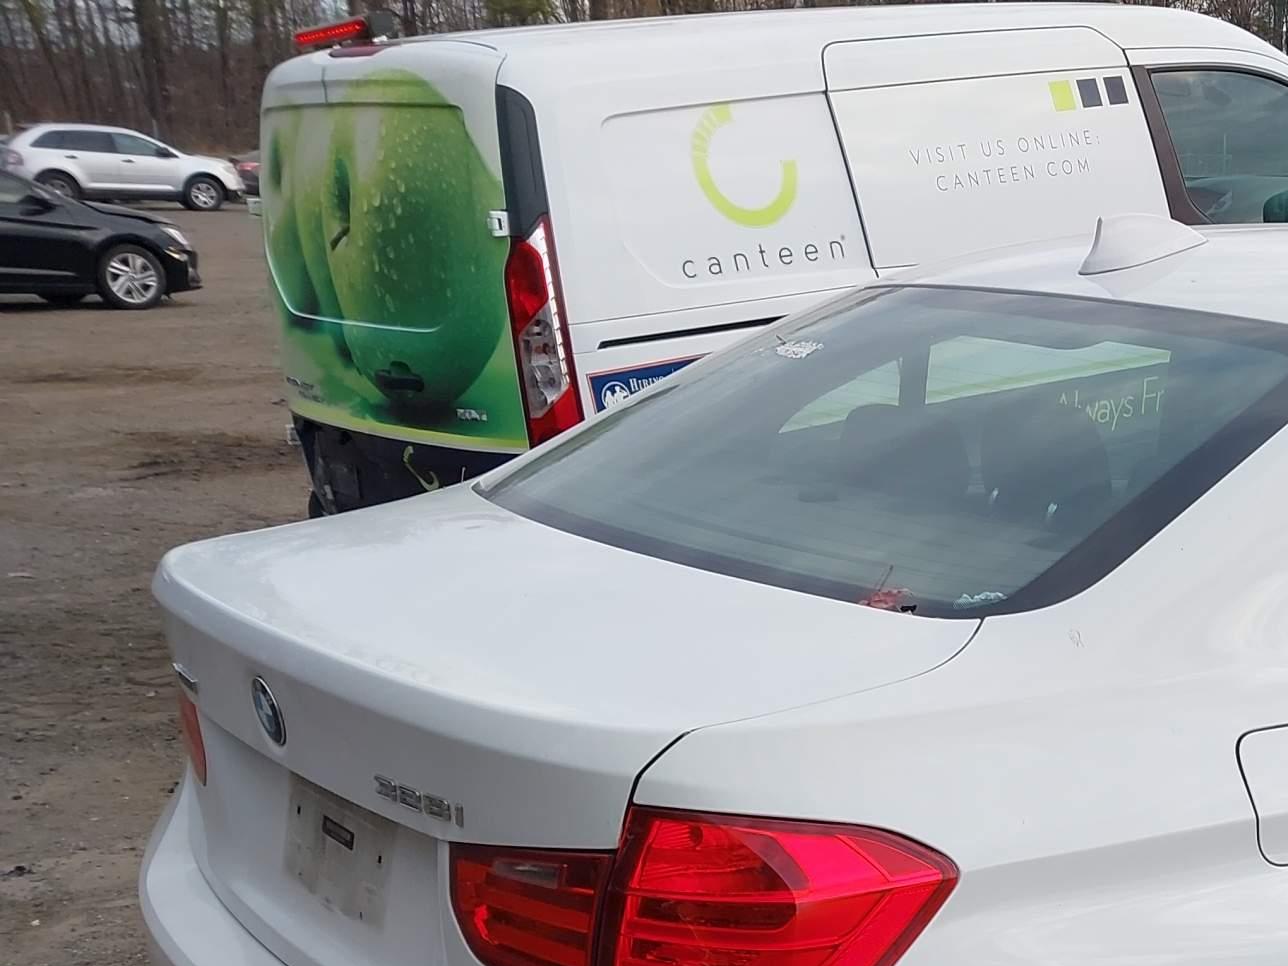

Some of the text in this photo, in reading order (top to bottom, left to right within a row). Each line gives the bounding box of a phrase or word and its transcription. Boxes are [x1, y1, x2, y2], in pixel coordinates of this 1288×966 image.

[909, 143, 968, 166] VISIT
[980, 139, 1006, 158] US
[936, 157, 1091, 192] CANTEEN COM
